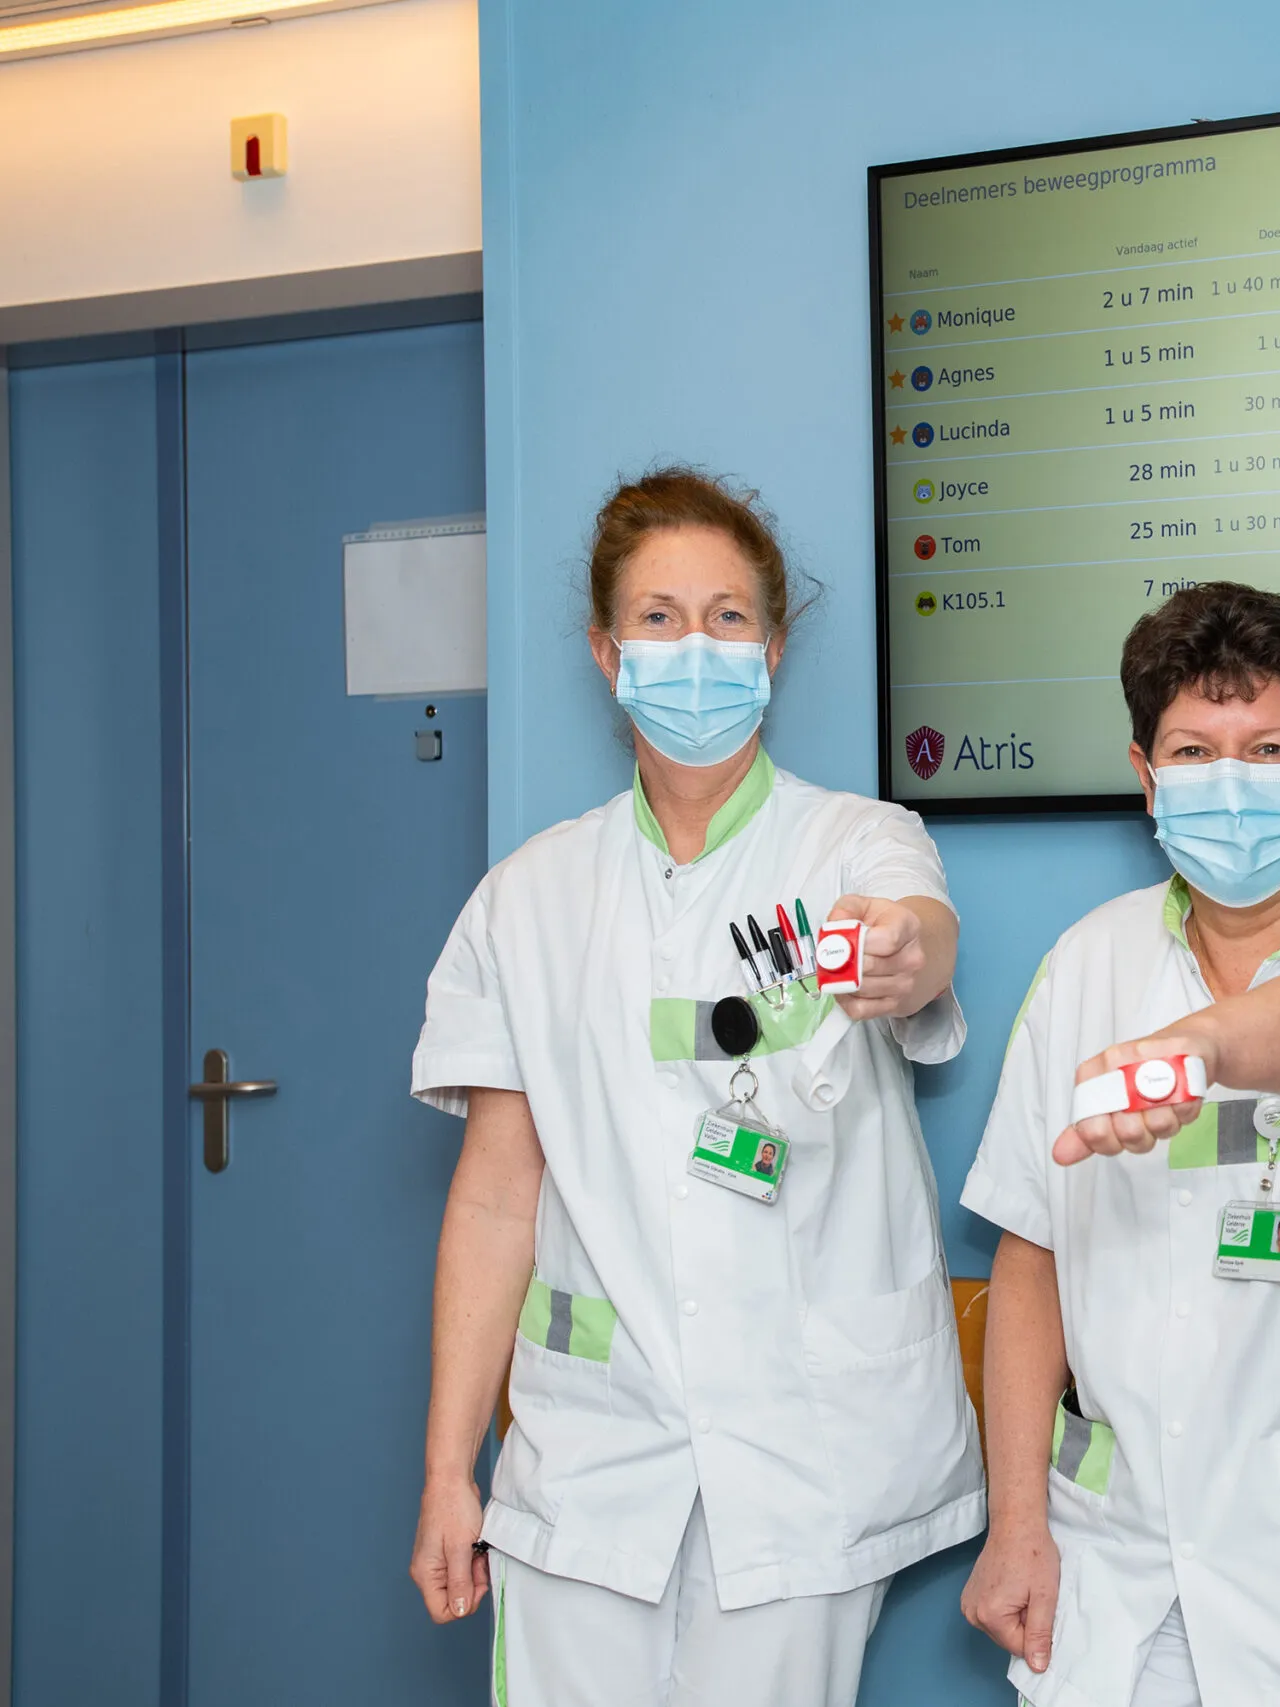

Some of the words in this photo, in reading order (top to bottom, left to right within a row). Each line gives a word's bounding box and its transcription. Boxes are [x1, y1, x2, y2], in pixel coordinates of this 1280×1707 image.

[904, 180, 1017, 209] Deelnemers
[1023, 156, 1216, 195] beweegprogramma
[1115, 240, 1164, 257] Vandaag
[1167, 237, 1199, 251] actief
[909, 267, 939, 280] Naam
[1211, 280, 1219, 295] 1
[1226, 282, 1237, 293] u
[1243, 275, 1264, 292] 40
[1102, 291, 1114, 309] 2
[1120, 292, 1133, 306] u
[1139, 287, 1151, 305] 7
[1156, 283, 1194, 303] min
[937, 306, 1016, 333] Monique
[1258, 335, 1266, 350] 1
[1104, 349, 1113, 367] 1
[1121, 351, 1134, 366] u
[1140, 346, 1152, 364] 5
[1158, 342, 1195, 362] min
[937, 364, 996, 387] Agnes
[1105, 408, 1114, 425] 1
[1122, 410, 1134, 424] u
[1141, 405, 1152, 423] 5
[1158, 401, 1196, 421] min
[1244, 396, 1265, 412] 30
[939, 419, 1011, 442] Lucinda
[1129, 463, 1153, 481] 28
[1159, 460, 1196, 478] min
[1214, 458, 1221, 473] 1
[1228, 459, 1239, 472] u
[1245, 456, 1266, 471] 30
[938, 480, 989, 501] Joyce
[1130, 522, 1153, 540] 25
[1161, 519, 1197, 537] min
[1215, 518, 1222, 533] 1
[1229, 519, 1240, 532] u
[1246, 515, 1267, 531] 30
[941, 536, 981, 554] Tom
[1143, 580, 1154, 597] 7
[942, 590, 1006, 611] K105.1
[952, 732, 1035, 772] Atris
